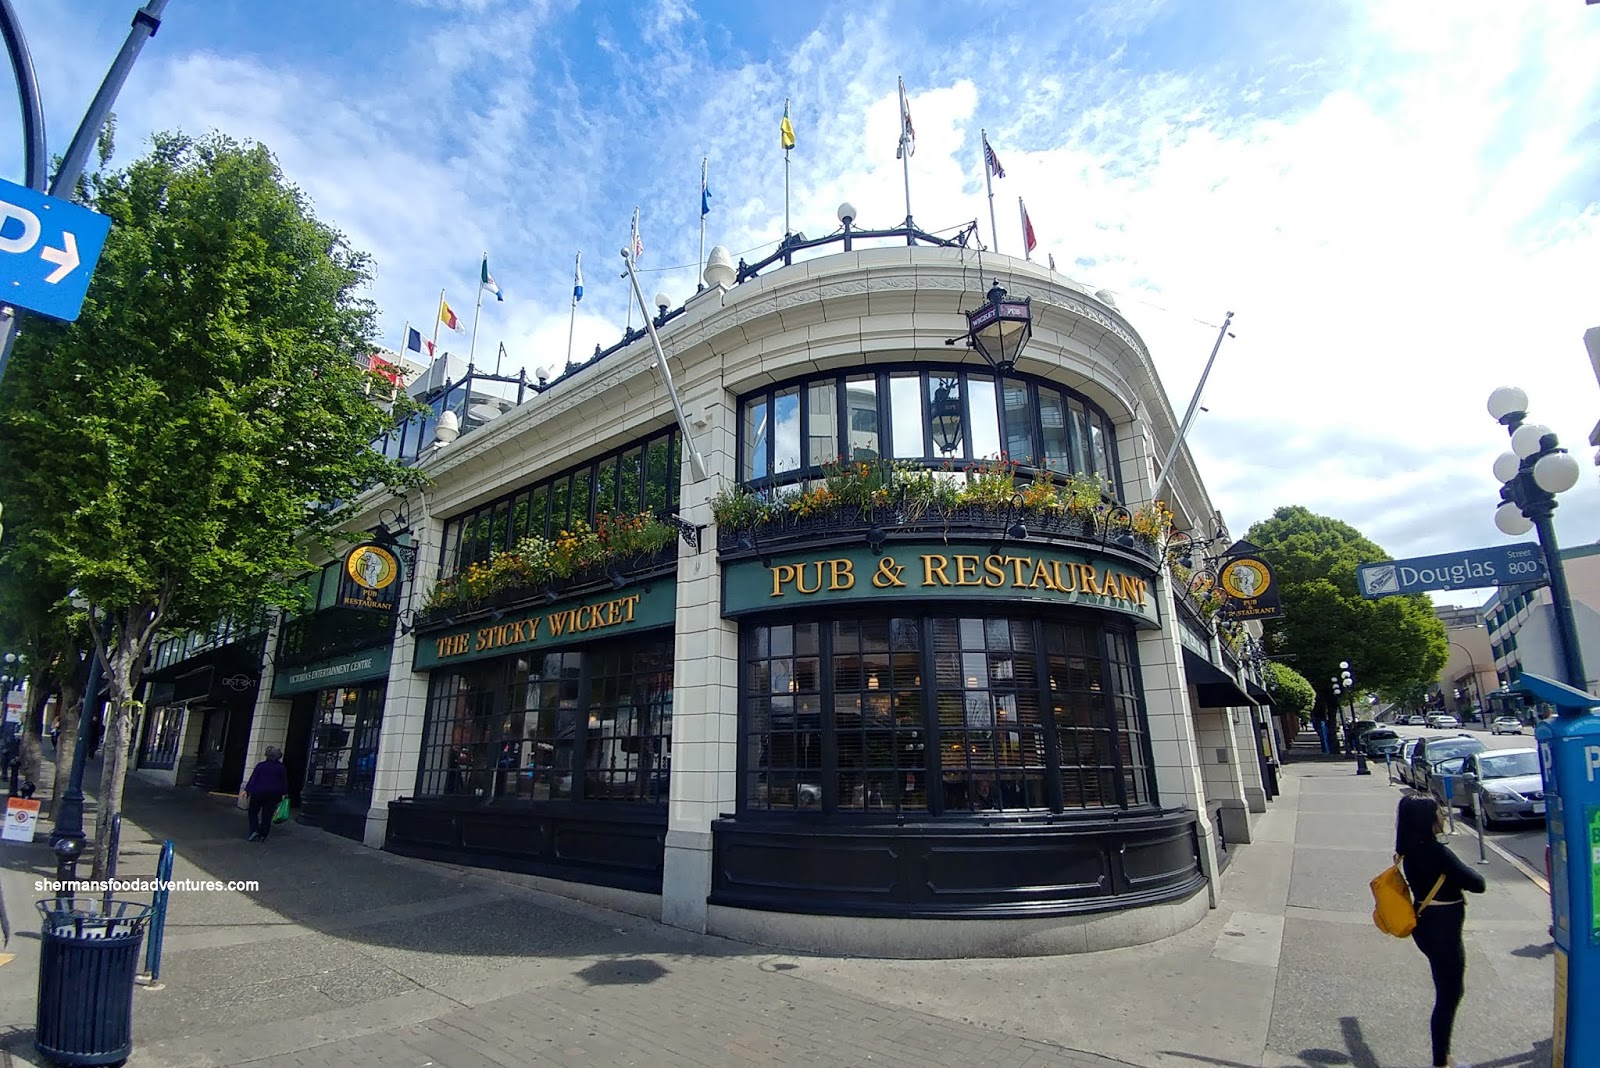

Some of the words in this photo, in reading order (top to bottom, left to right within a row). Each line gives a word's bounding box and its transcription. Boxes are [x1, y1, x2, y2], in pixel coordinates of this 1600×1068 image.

[972, 309, 996, 326] WICKET
[1007, 307, 1021, 315] PUB
[1507, 549, 1532, 558] Street
[1400, 558, 1496, 587] Douglas
[1509, 560, 1538, 575] 800
[771, 557, 856, 596] PUB
[872, 555, 906, 588] &
[921, 553, 1148, 607] RESTAURANT
[344, 597, 392, 610] RESTAURANT
[1228, 606, 1276, 617] RSTAURANT
[436, 633, 470, 658] THE
[475, 617, 540, 650] STICKY
[548, 594, 640, 637] WICKET
[312, 663, 351, 680] ENTERTAINMENT
[350, 658, 372, 672] CENTRE
